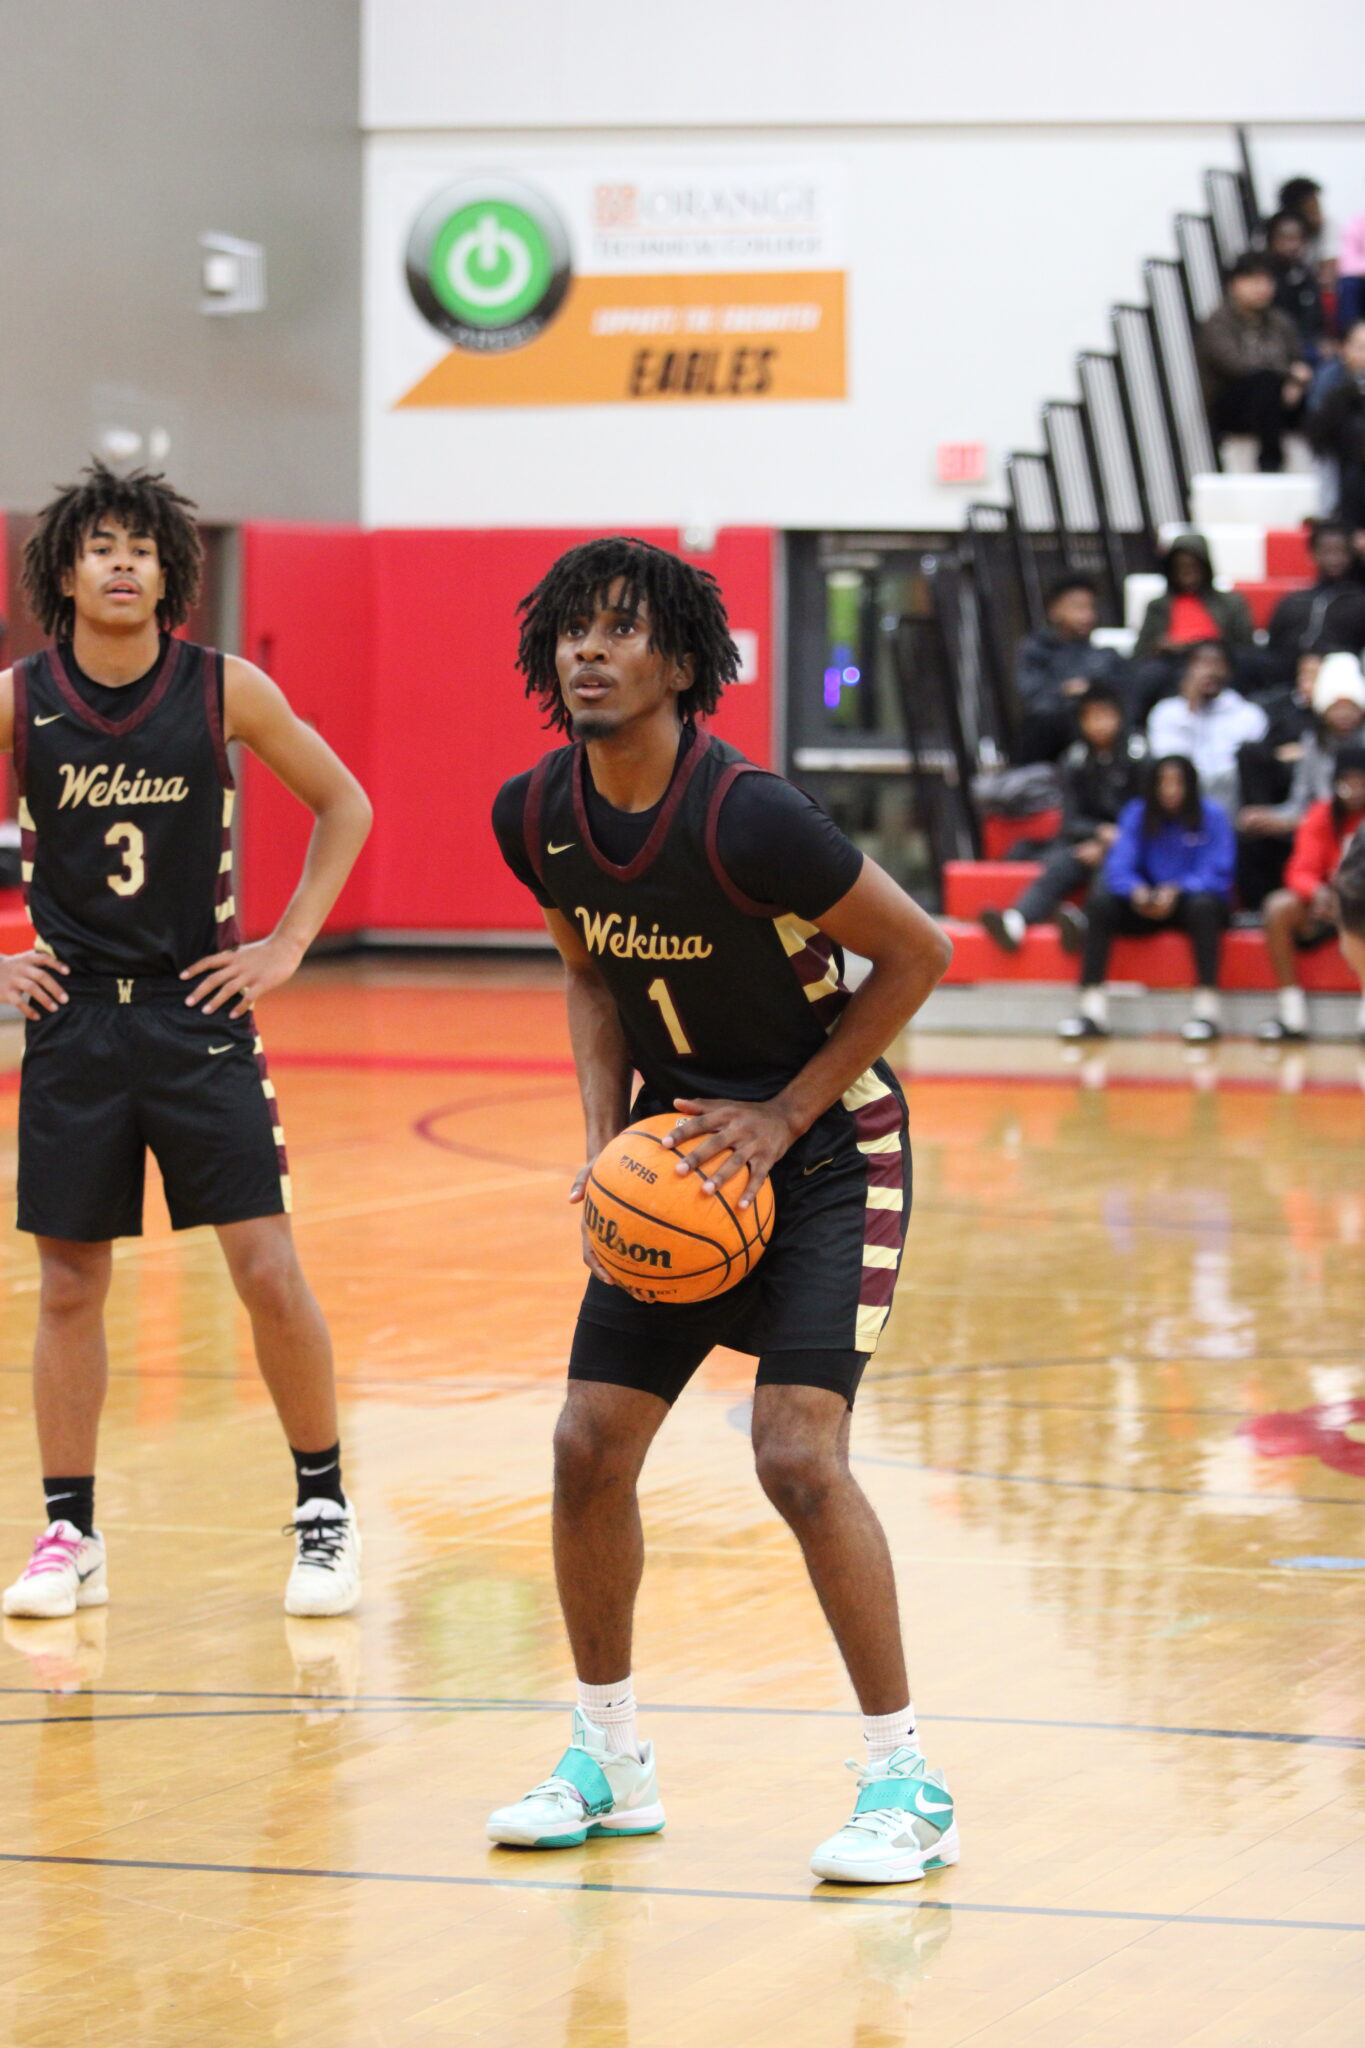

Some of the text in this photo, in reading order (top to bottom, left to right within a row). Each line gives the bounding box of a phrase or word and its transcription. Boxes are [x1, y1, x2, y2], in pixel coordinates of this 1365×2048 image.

[642, 184, 817, 219] ORANGE
[628, 346, 778, 398] EAGLES
[57, 763, 189, 810] Wekiva
[104, 821, 146, 897] 3
[575, 906, 712, 960] Wekiva
[116, 978, 135, 1004] W
[648, 978, 693, 1055] 1
[624, 1158, 659, 1185] NFHS
